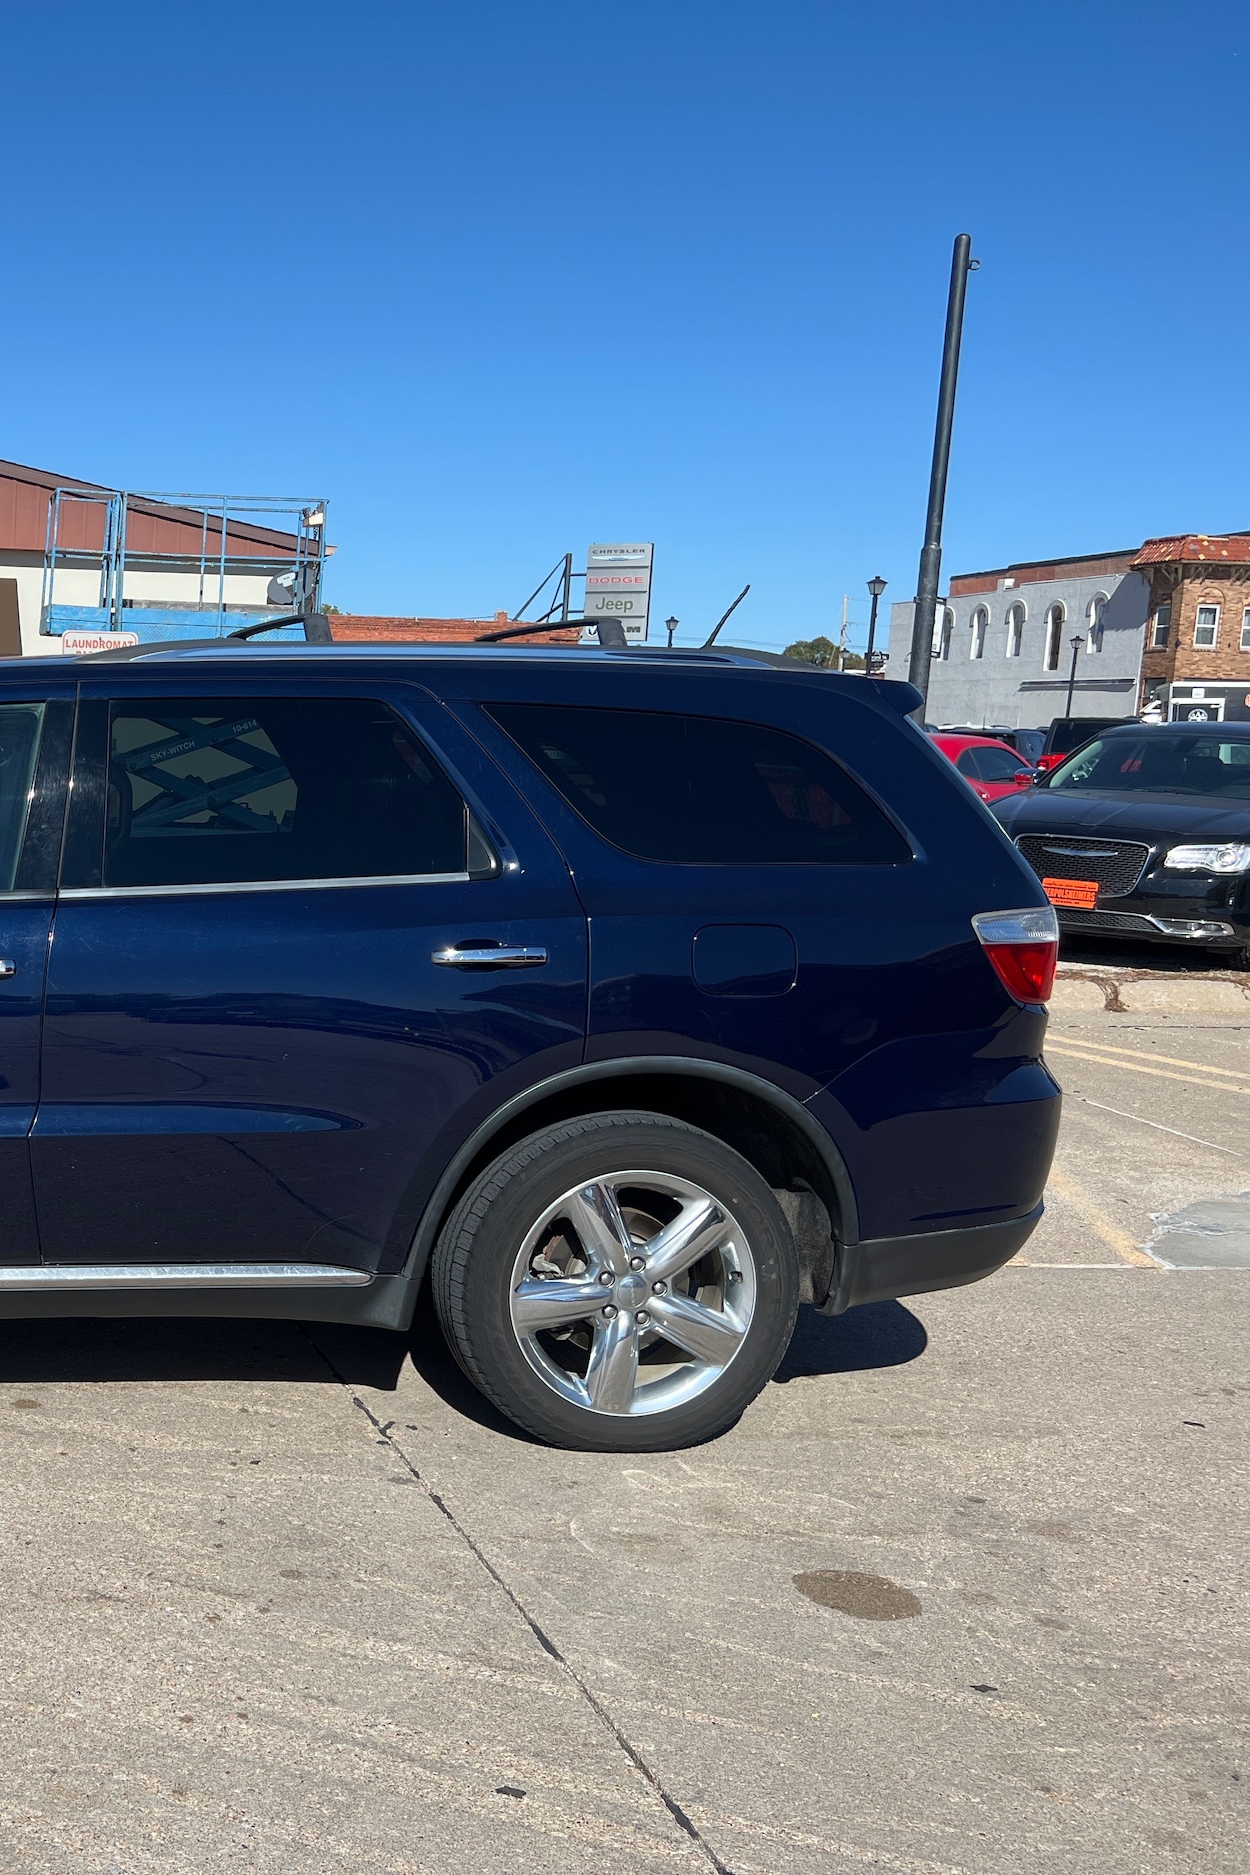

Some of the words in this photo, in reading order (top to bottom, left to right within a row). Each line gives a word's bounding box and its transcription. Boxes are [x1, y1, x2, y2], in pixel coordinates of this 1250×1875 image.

[595, 597, 634, 613] Jeep
[150, 740, 196, 762] SKY-WITCH
[232, 719, 258, 734] 10-614
